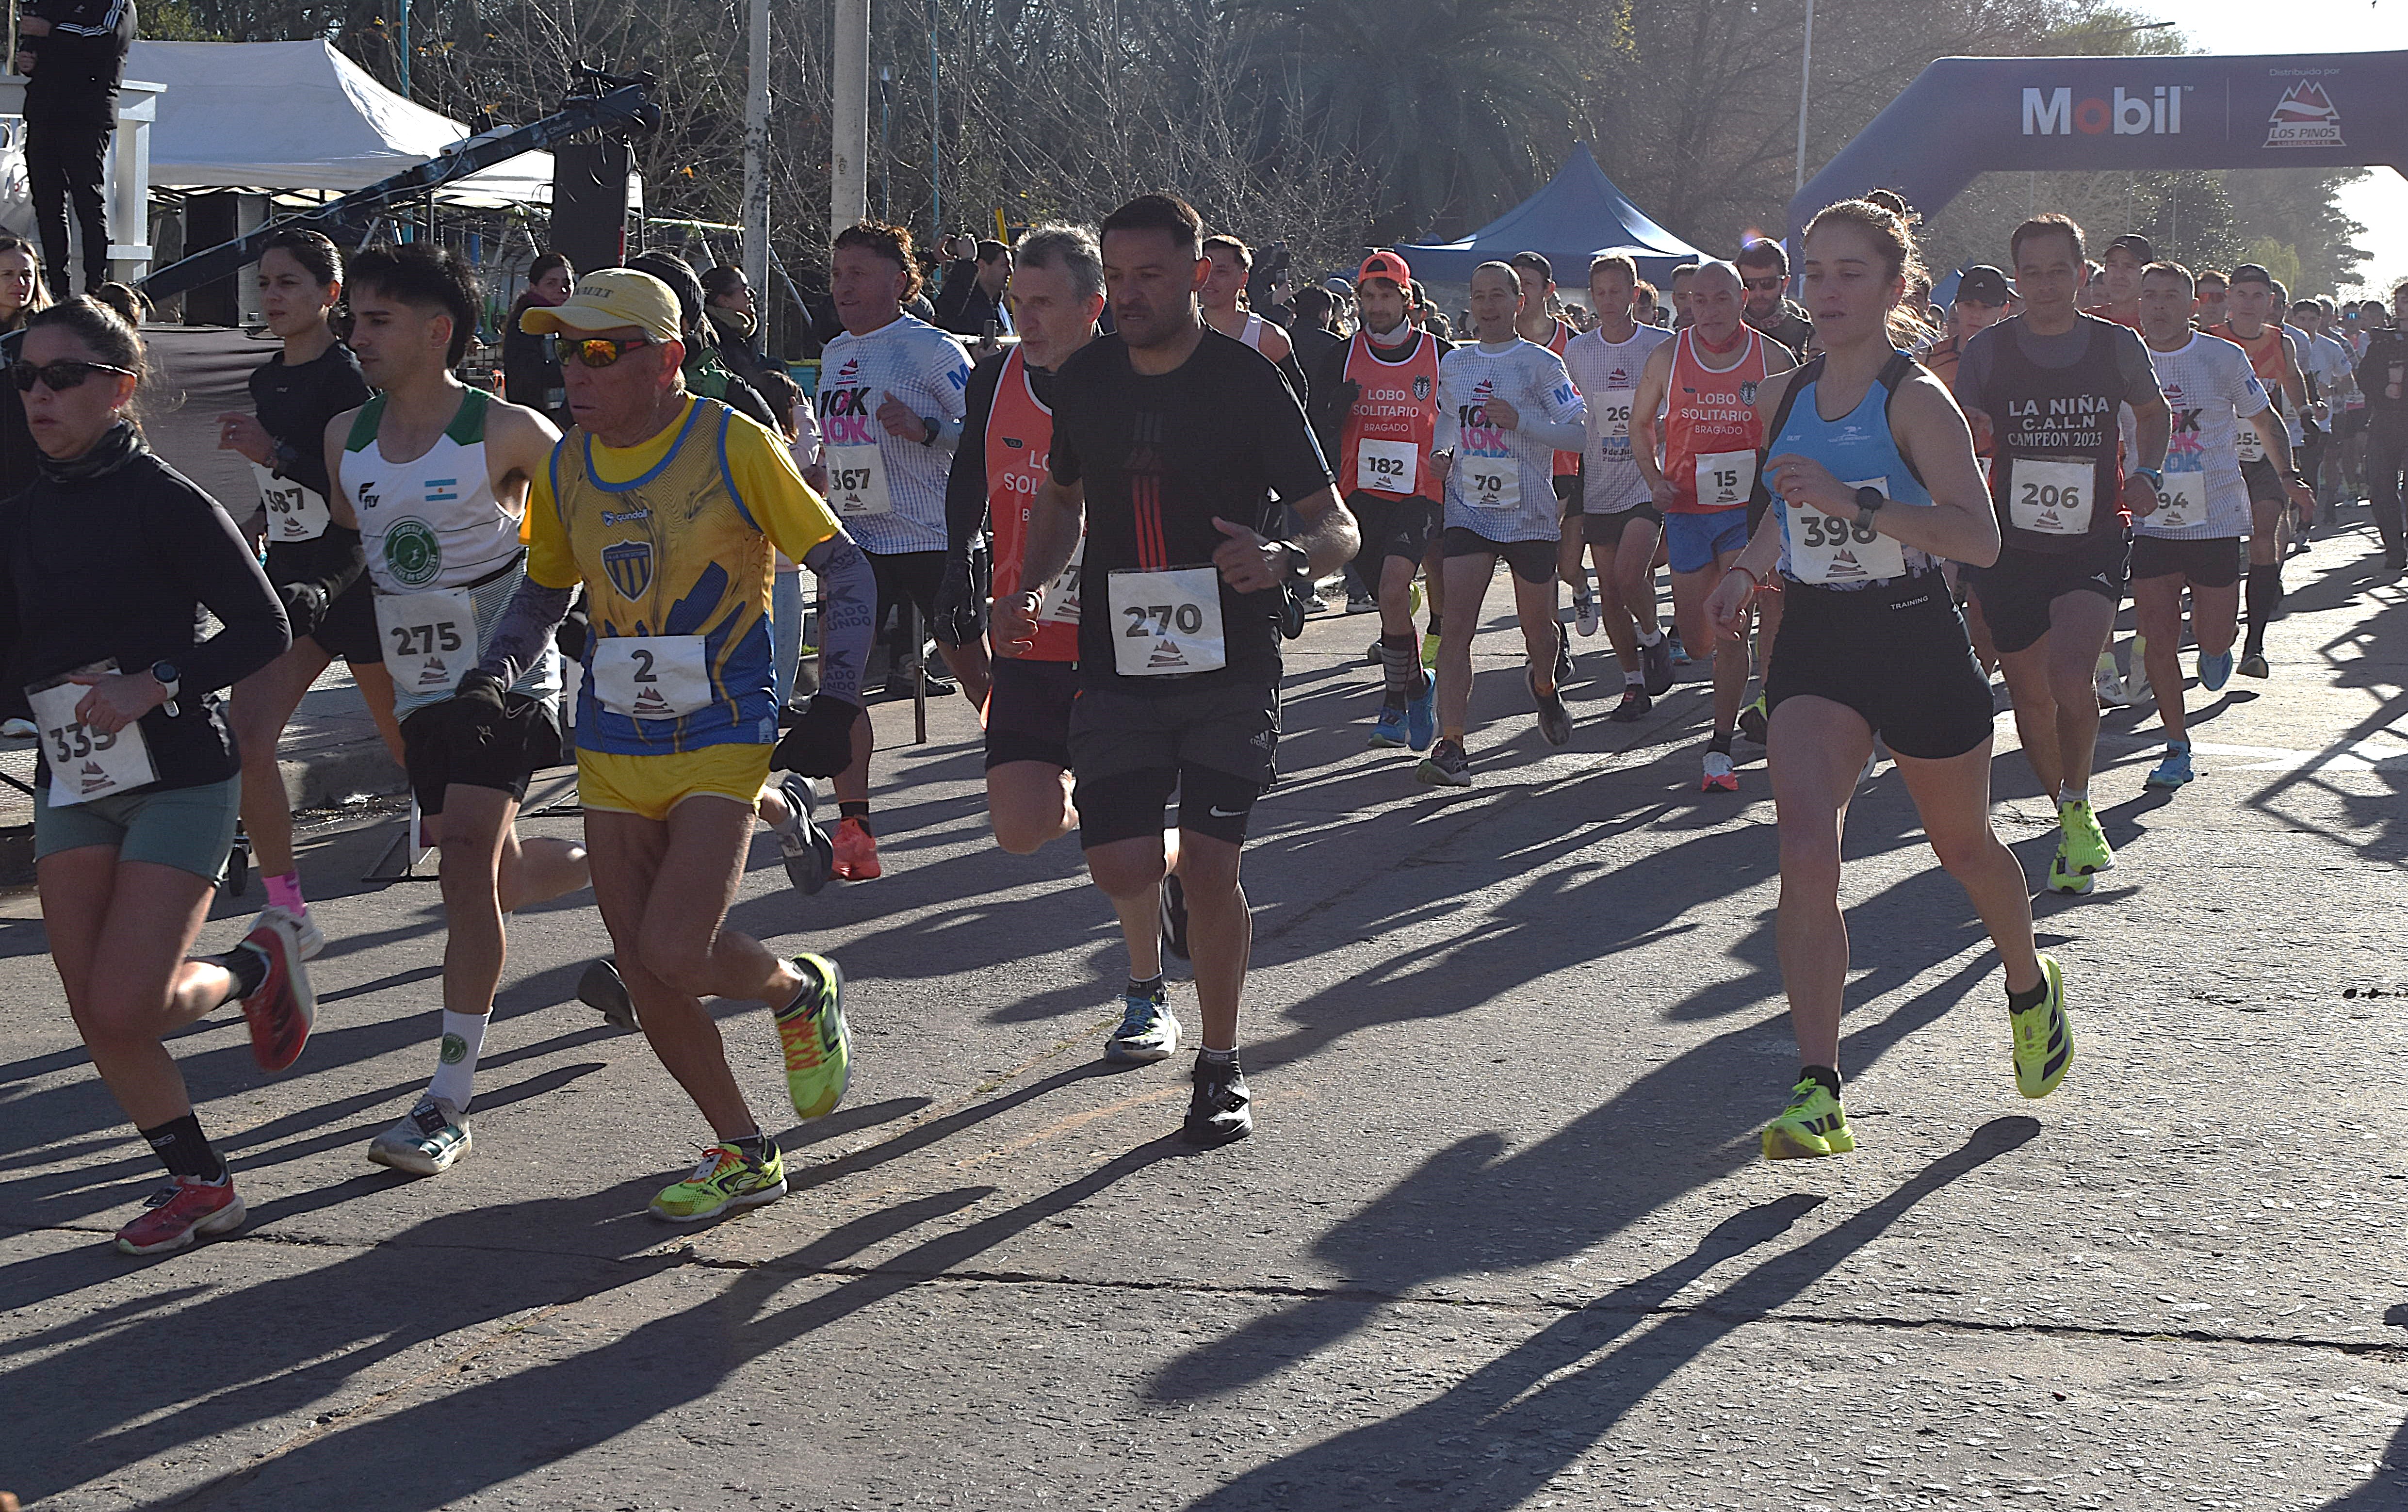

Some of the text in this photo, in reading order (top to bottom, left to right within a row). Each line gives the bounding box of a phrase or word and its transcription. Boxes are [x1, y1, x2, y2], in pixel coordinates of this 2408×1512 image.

[2269, 68, 2341, 77] Distribuido por
[2022, 86, 2180, 135] Mobil
[2271, 128, 2336, 138] LOS PINOS
[820, 387, 872, 418] 10K
[1367, 389, 1406, 402] LOBO
[1697, 392, 1737, 405] LOBO
[1353, 405, 1419, 418] SOLITARIO
[2009, 394, 2110, 417] LA NIÑA
[1606, 406, 1630, 422] 26
[1681, 407, 1752, 422] SOLITARIO
[1364, 423, 1409, 432] BRAGADO
[1694, 424, 1742, 435] BRAGADO
[2022, 415, 2096, 431] C.A.L.N
[2007, 431, 2103, 448] CAMPEON 2023
[1367, 456, 1403, 476] 182
[831, 468, 870, 491] 367
[1474, 475, 1502, 491] 70
[1714, 470, 1738, 488] 15
[265, 488, 304, 514] 387
[2021, 482, 2080, 509] 206
[2158, 491, 2189, 510] 94
[1889, 595, 1929, 610] TRAINING
[826, 616, 871, 632] UNDO
[1122, 603, 1202, 637] 270
[390, 621, 461, 655] 275
[631, 649, 657, 683] 2
